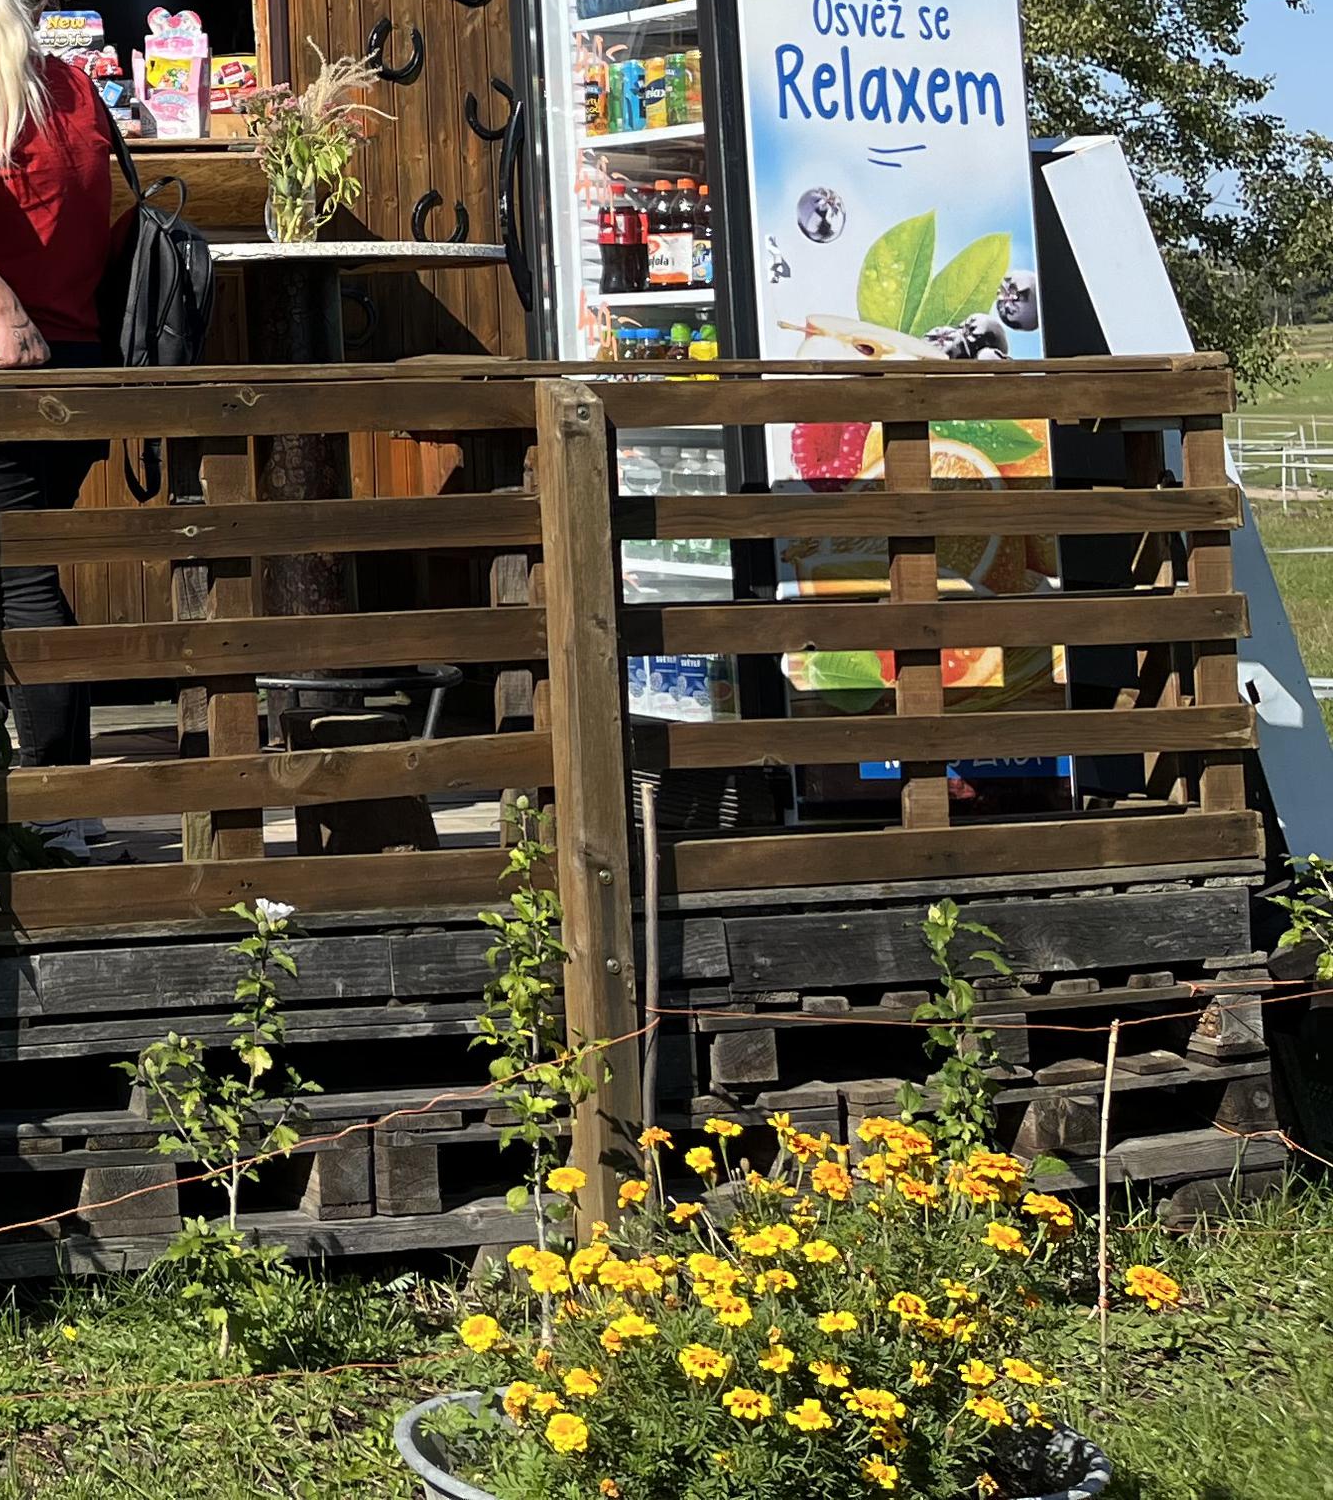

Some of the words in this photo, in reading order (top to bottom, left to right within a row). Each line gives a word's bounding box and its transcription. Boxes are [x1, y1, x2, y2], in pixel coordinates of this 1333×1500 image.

[47, 16, 85, 30] New
[918, 6, 950, 40] se
[644, 85, 666, 99] elax
[775, 43, 1005, 126] Relaxem
